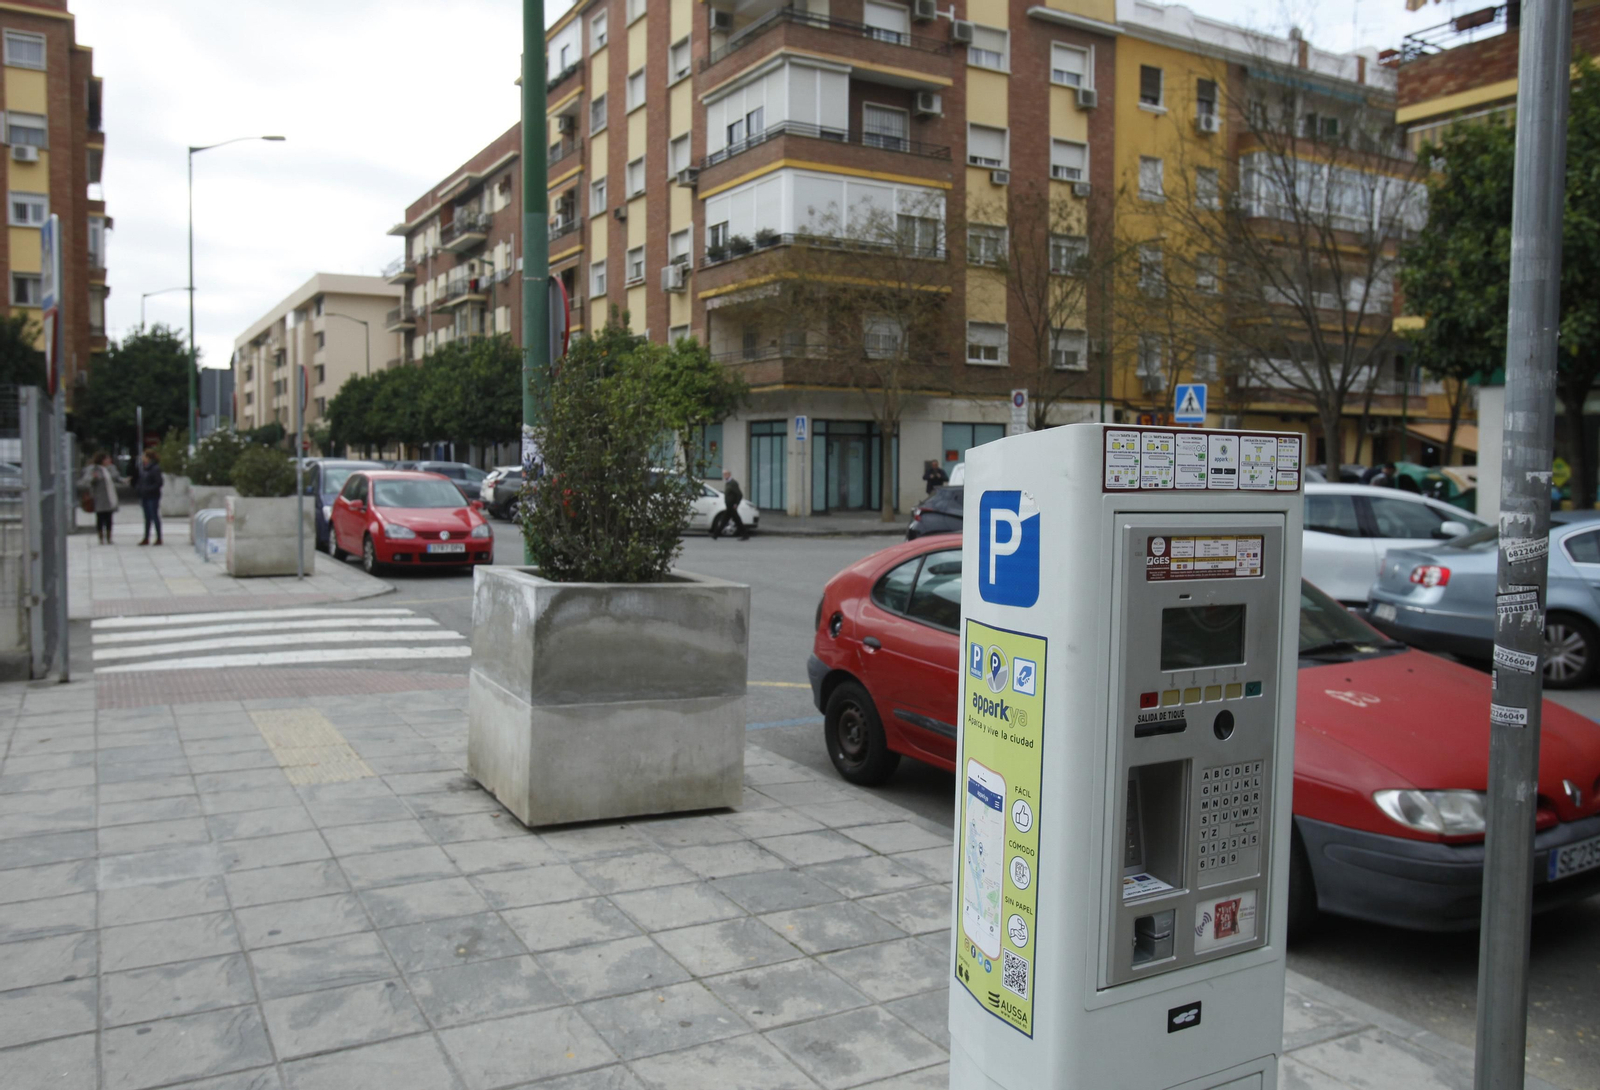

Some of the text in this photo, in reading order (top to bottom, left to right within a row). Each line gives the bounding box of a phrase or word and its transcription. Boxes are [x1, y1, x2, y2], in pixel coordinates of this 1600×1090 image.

[989, 508, 1022, 585] P
[1138, 710, 1184, 723] SALIDA DE TIQUE
[968, 715, 982, 729] Aparca
[987, 726, 999, 737] vive
[1001, 730, 1007, 740] la
[1010, 734, 1034, 748] ciudad
[1005, 896, 1033, 915] SIN PAPEL
[1001, 1000, 1028, 1023] AUSSA
